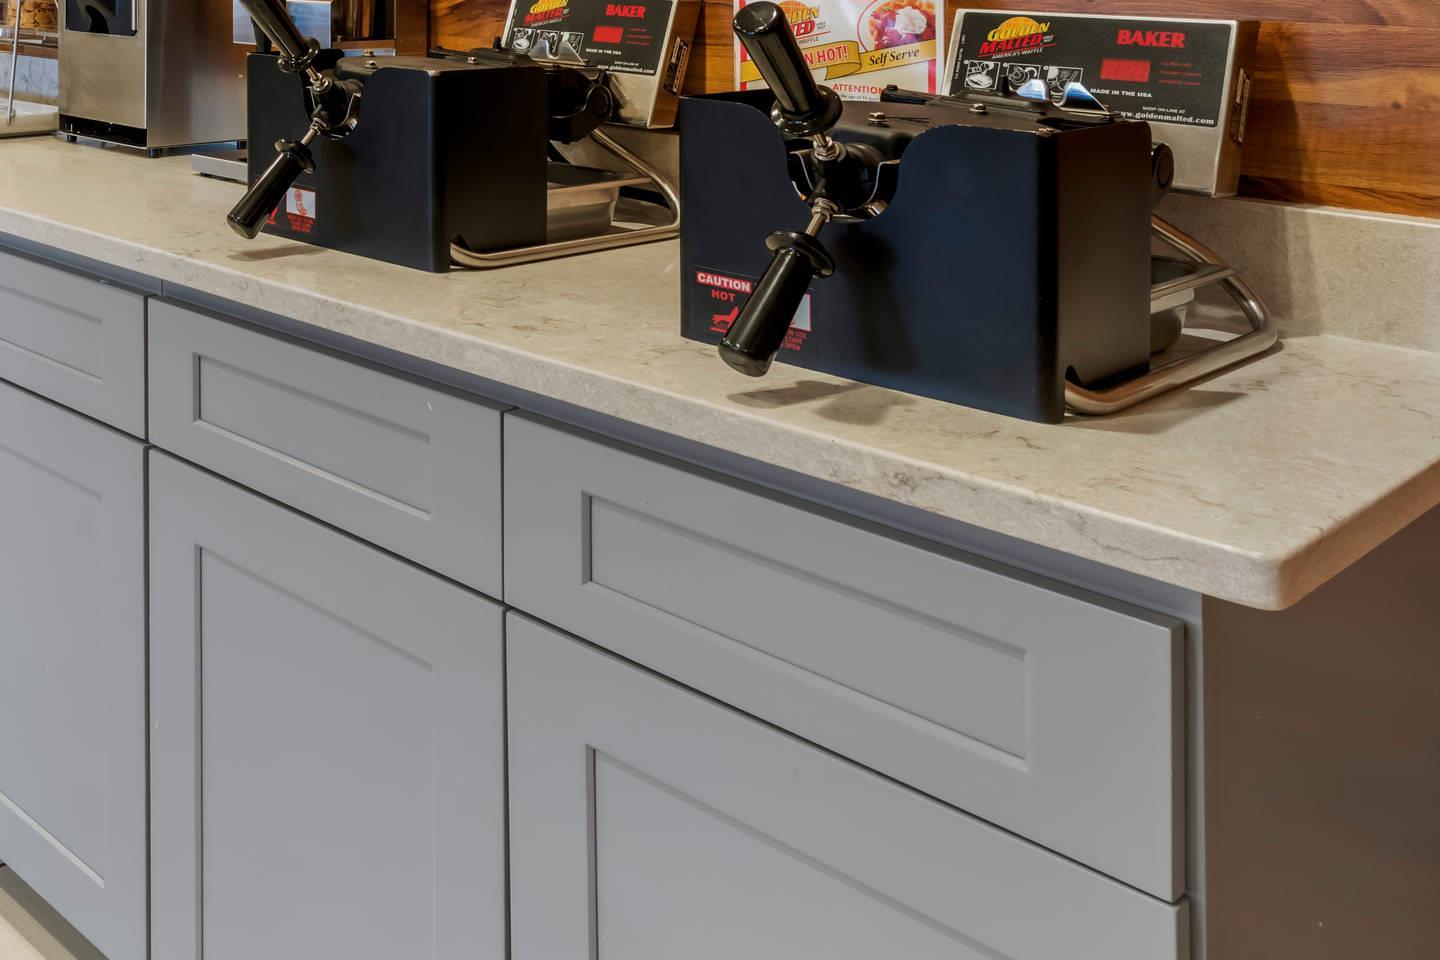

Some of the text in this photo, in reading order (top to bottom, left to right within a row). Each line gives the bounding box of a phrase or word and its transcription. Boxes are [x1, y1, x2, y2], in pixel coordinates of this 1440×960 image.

[605, 4, 647, 18] BAKER
[987, 22, 1051, 42] GOLDEN
[1117, 29, 1186, 49] BAKER
[979, 33, 1043, 55] MALTED
[1021, 48, 1043, 56] WAFFLE
[817, 46, 848, 63] HOT!
[868, 48, 920, 67] Self Serve
[697, 272, 751, 293] CAUTION
[711, 289, 736, 302] HOT
